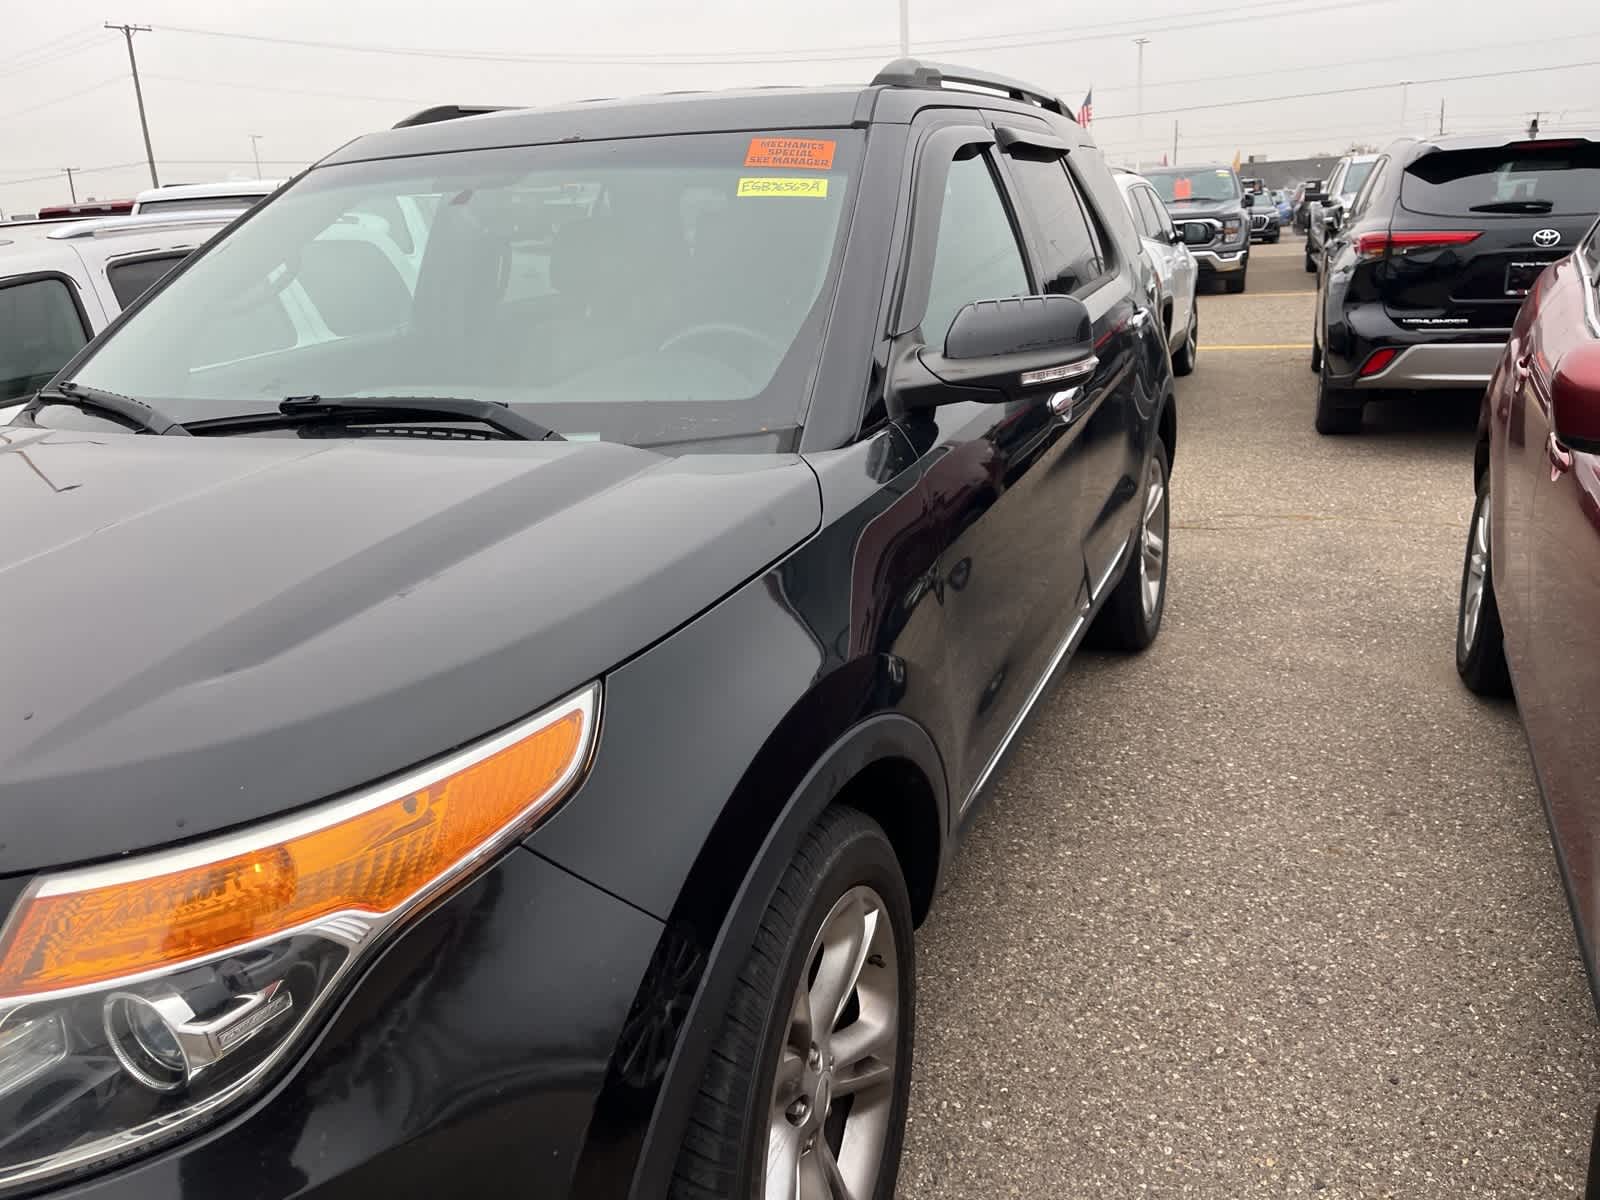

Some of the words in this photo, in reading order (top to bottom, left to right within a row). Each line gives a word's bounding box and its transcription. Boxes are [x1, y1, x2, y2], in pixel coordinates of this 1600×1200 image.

[760, 140, 824, 150] MECHANICS
[768, 149, 813, 157] SPECIAL
[773, 156, 829, 167] MANAGER
